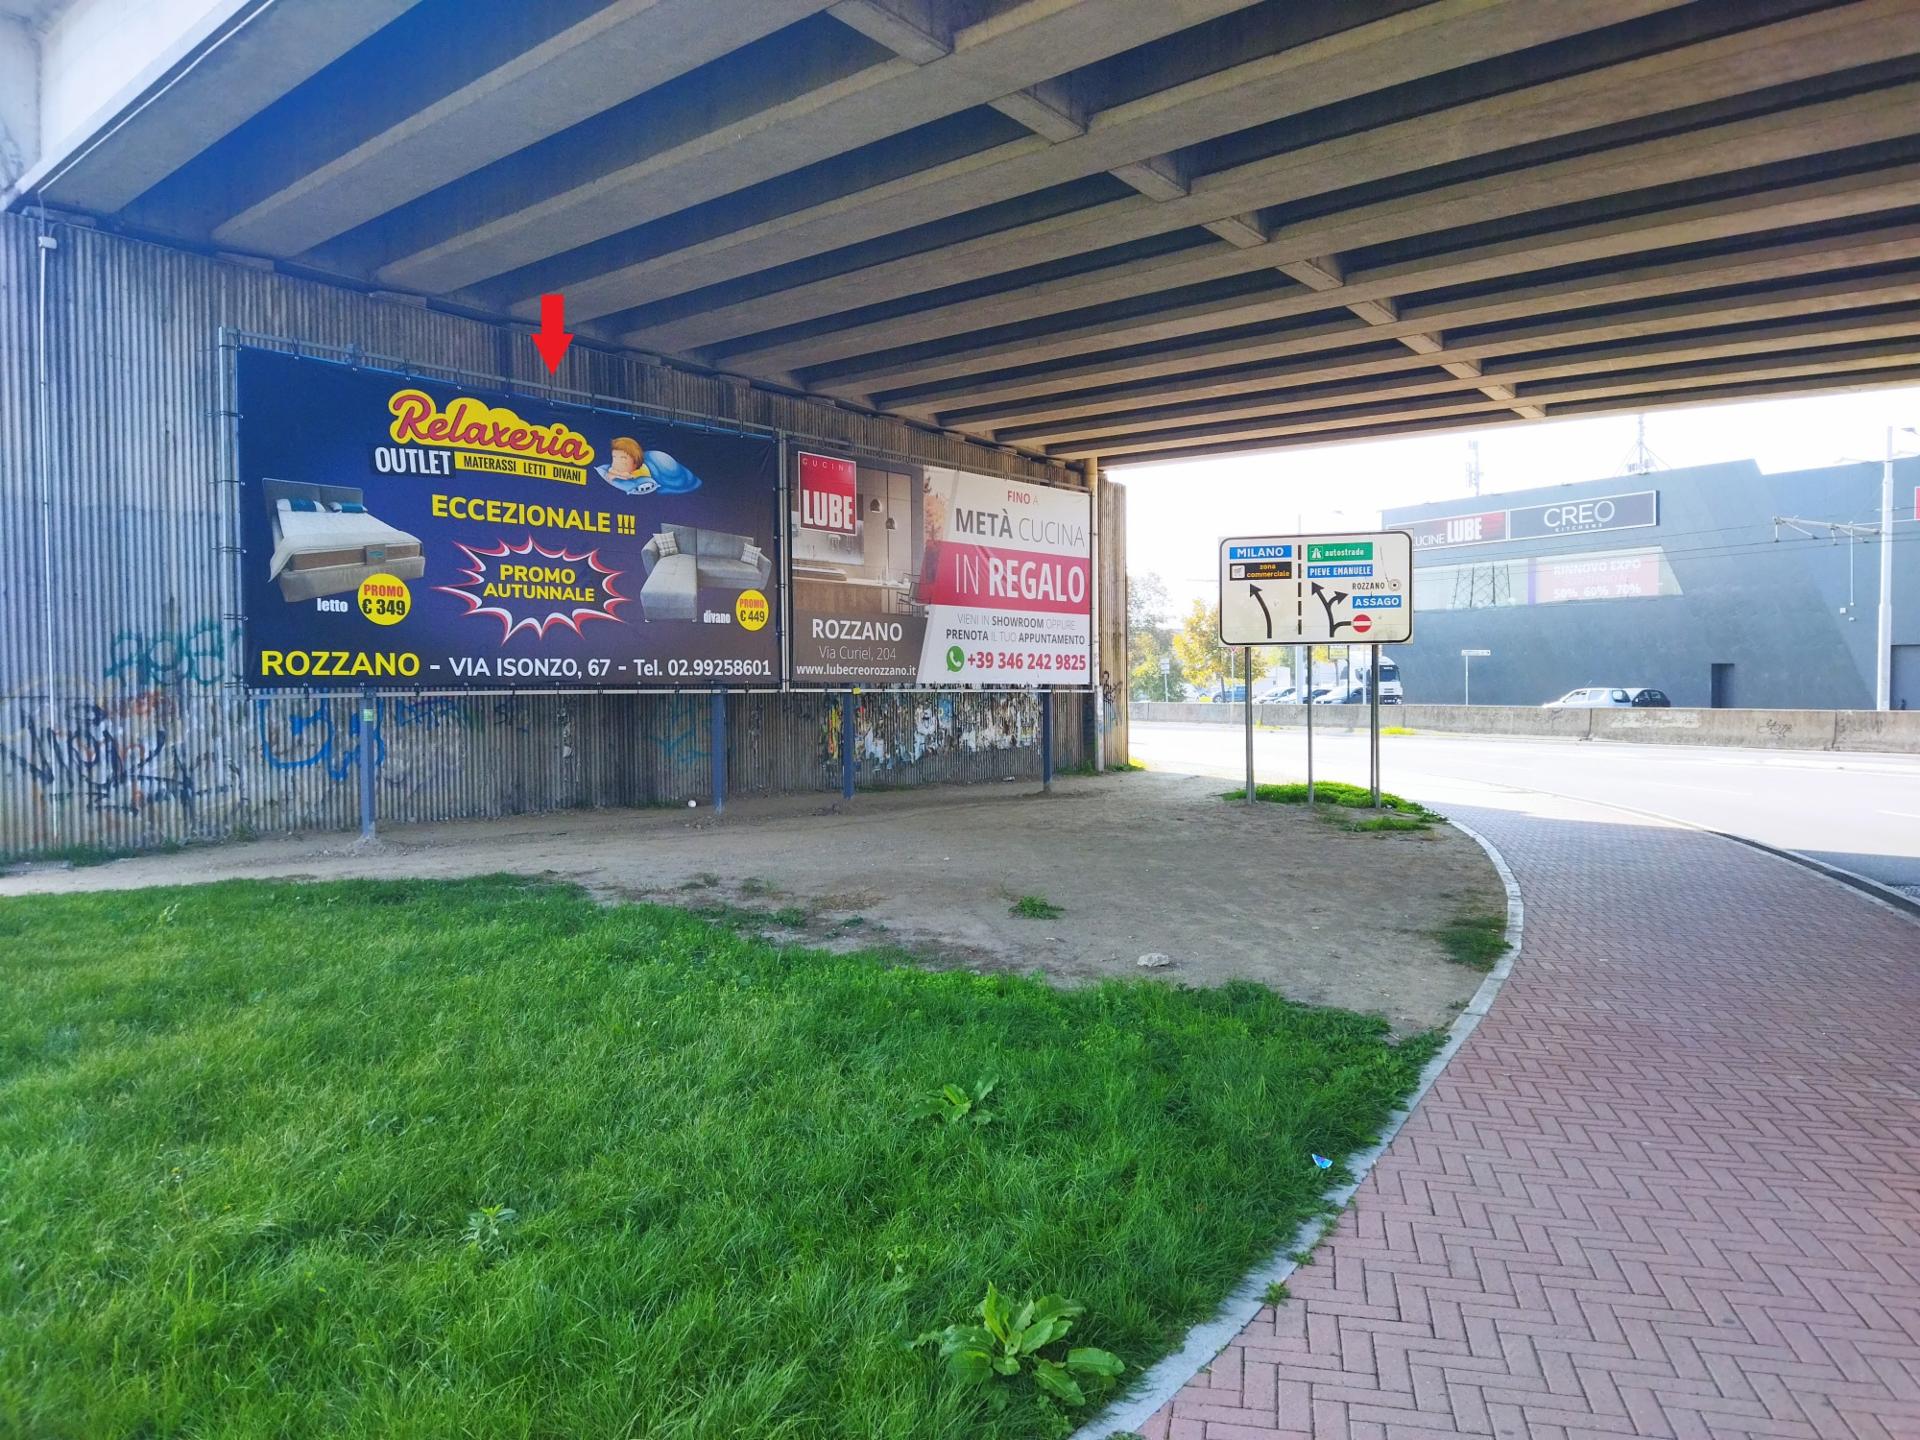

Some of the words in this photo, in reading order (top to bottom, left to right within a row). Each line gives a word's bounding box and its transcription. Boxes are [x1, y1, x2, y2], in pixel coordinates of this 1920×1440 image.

[393, 394, 590, 460] Relaxeria
[375, 447, 450, 475] OUTLET
[463, 455, 517, 473] MATERASSI
[523, 462, 546, 476] LETTI
[553, 466, 581, 482] DIVANI
[802, 457, 853, 473] CUCINE
[1007, 490, 1031, 504] FINO
[1033, 495, 1040, 505] A
[431, 494, 611, 533] ECCEZIONALE
[617, 514, 636, 535] !!!
[803, 489, 853, 530] LUBE
[1544, 501, 1615, 527] CREO
[956, 508, 1013, 539] METÀ
[1018, 517, 1085, 547] CUCINA
[1413, 533, 1445, 547] UCINE
[1447, 517, 1482, 543] LUBE
[1236, 547, 1284, 558] MILANO
[1309, 567, 1331, 576] PIEVE
[1333, 566, 1372, 576] EMANUELE
[1610, 558, 1642, 571] EXPO
[500, 564, 576, 584] PROMO
[956, 553, 979, 595] IN
[989, 556, 1085, 603] REGALO
[1246, 570, 1290, 578] commerciale
[363, 584, 404, 597] PROMO
[483, 583, 595, 602] AUTUNNALE
[1352, 582, 1385, 590] ROZZANO
[316, 597, 348, 613] letto
[362, 599, 372, 614] €
[376, 599, 406, 616] 349
[739, 598, 764, 609] PROMO
[1354, 597, 1399, 607] ASSAGO
[703, 609, 731, 624] divano
[748, 611, 765, 622] 449
[992, 615, 1044, 629] SHOWROOM
[812, 618, 903, 641] ROZZANO
[946, 629, 988, 641] PRENOTA
[999, 632, 1017, 642] TUO
[1018, 633, 1085, 645] APPUNTAMENTO
[819, 645, 836, 659] Via
[840, 645, 874, 660] Curiel,
[876, 647, 896, 660] 204
[261, 650, 421, 677] ROZZANO
[449, 657, 490, 676] VIA
[497, 658, 582, 679] ISONZO,
[588, 659, 610, 676] 67
[633, 659, 662, 676] Tel.
[668, 660, 771, 676] 02.99258601
[968, 651, 994, 669] +39
[998, 652, 1023, 670] 346
[1028, 653, 1052, 670] 242
[1056, 654, 1086, 671] 9825
[796, 663, 916, 676] www.lubecreorozzano.it
